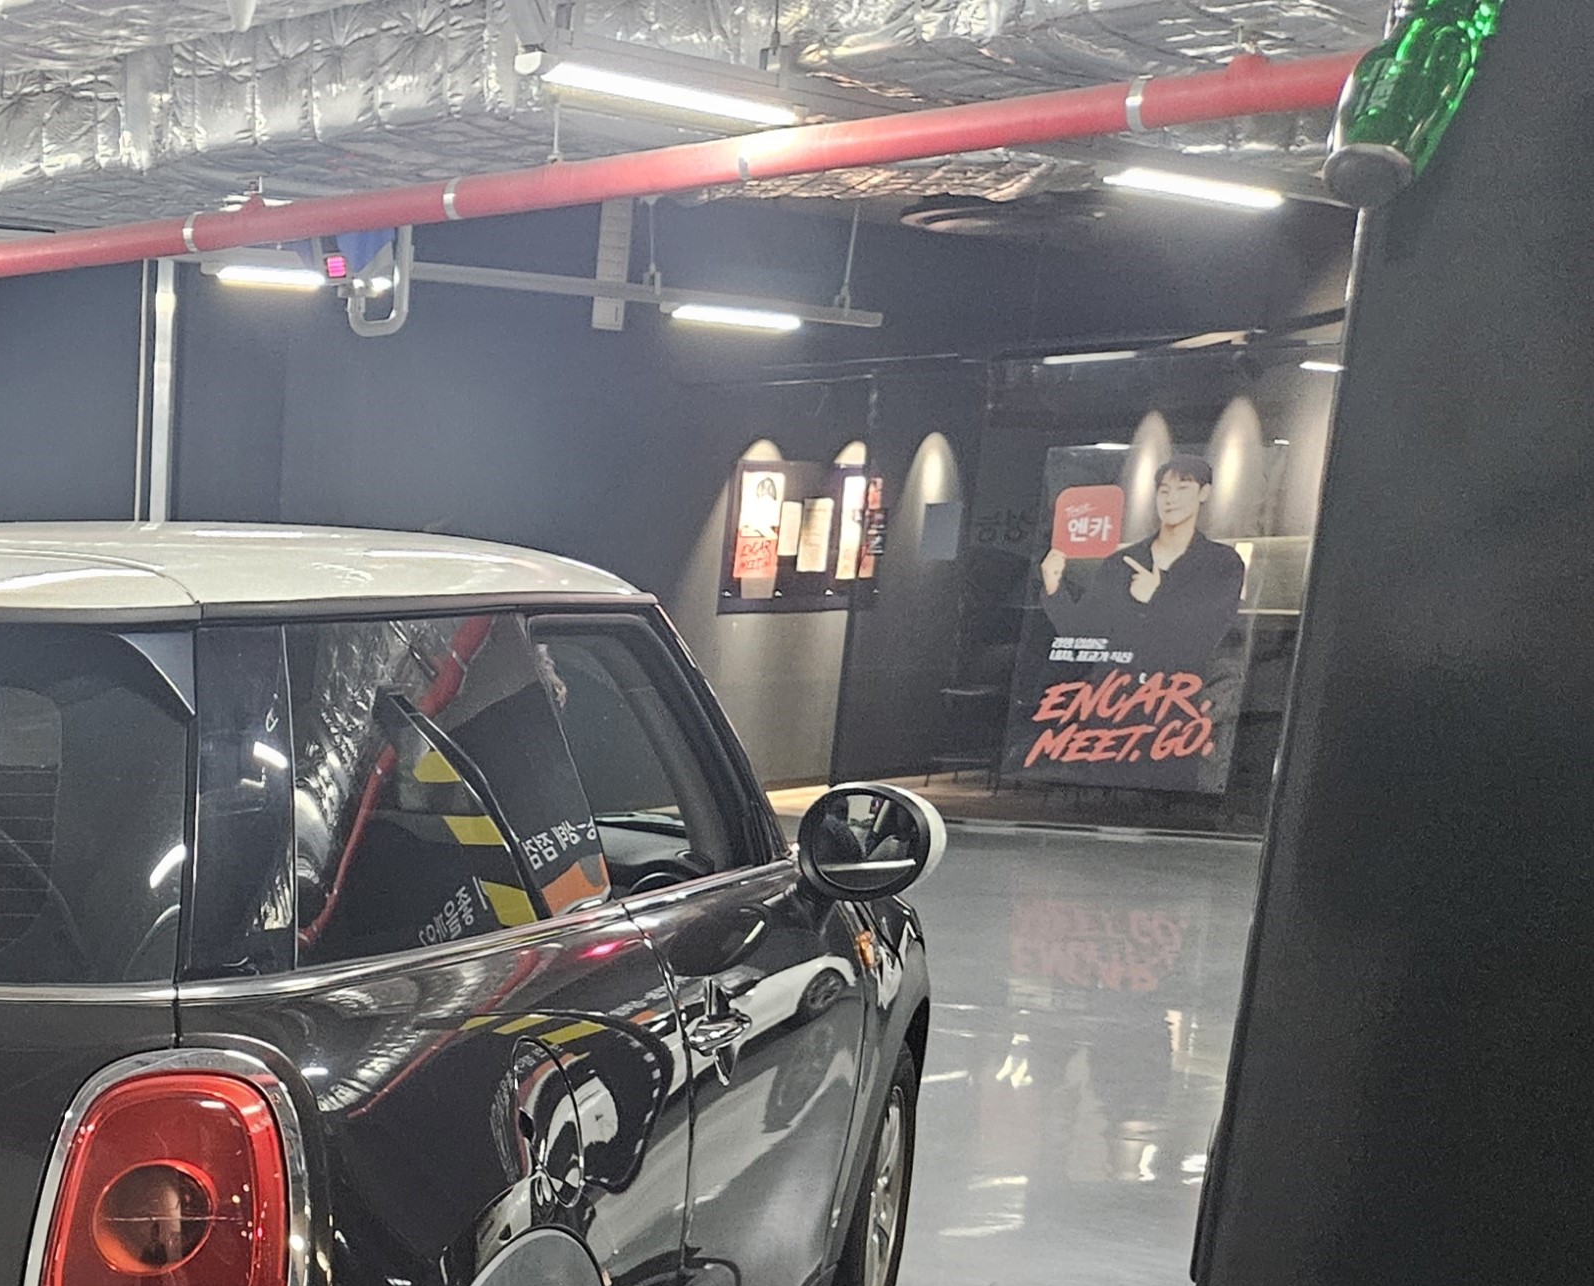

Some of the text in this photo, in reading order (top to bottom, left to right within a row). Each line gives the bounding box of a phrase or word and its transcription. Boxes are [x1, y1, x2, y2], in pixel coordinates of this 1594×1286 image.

[1067, 514, 1113, 542] 엔카
[1032, 668, 1212, 724] ENCAR.
[1150, 717, 1215, 761] GO.
